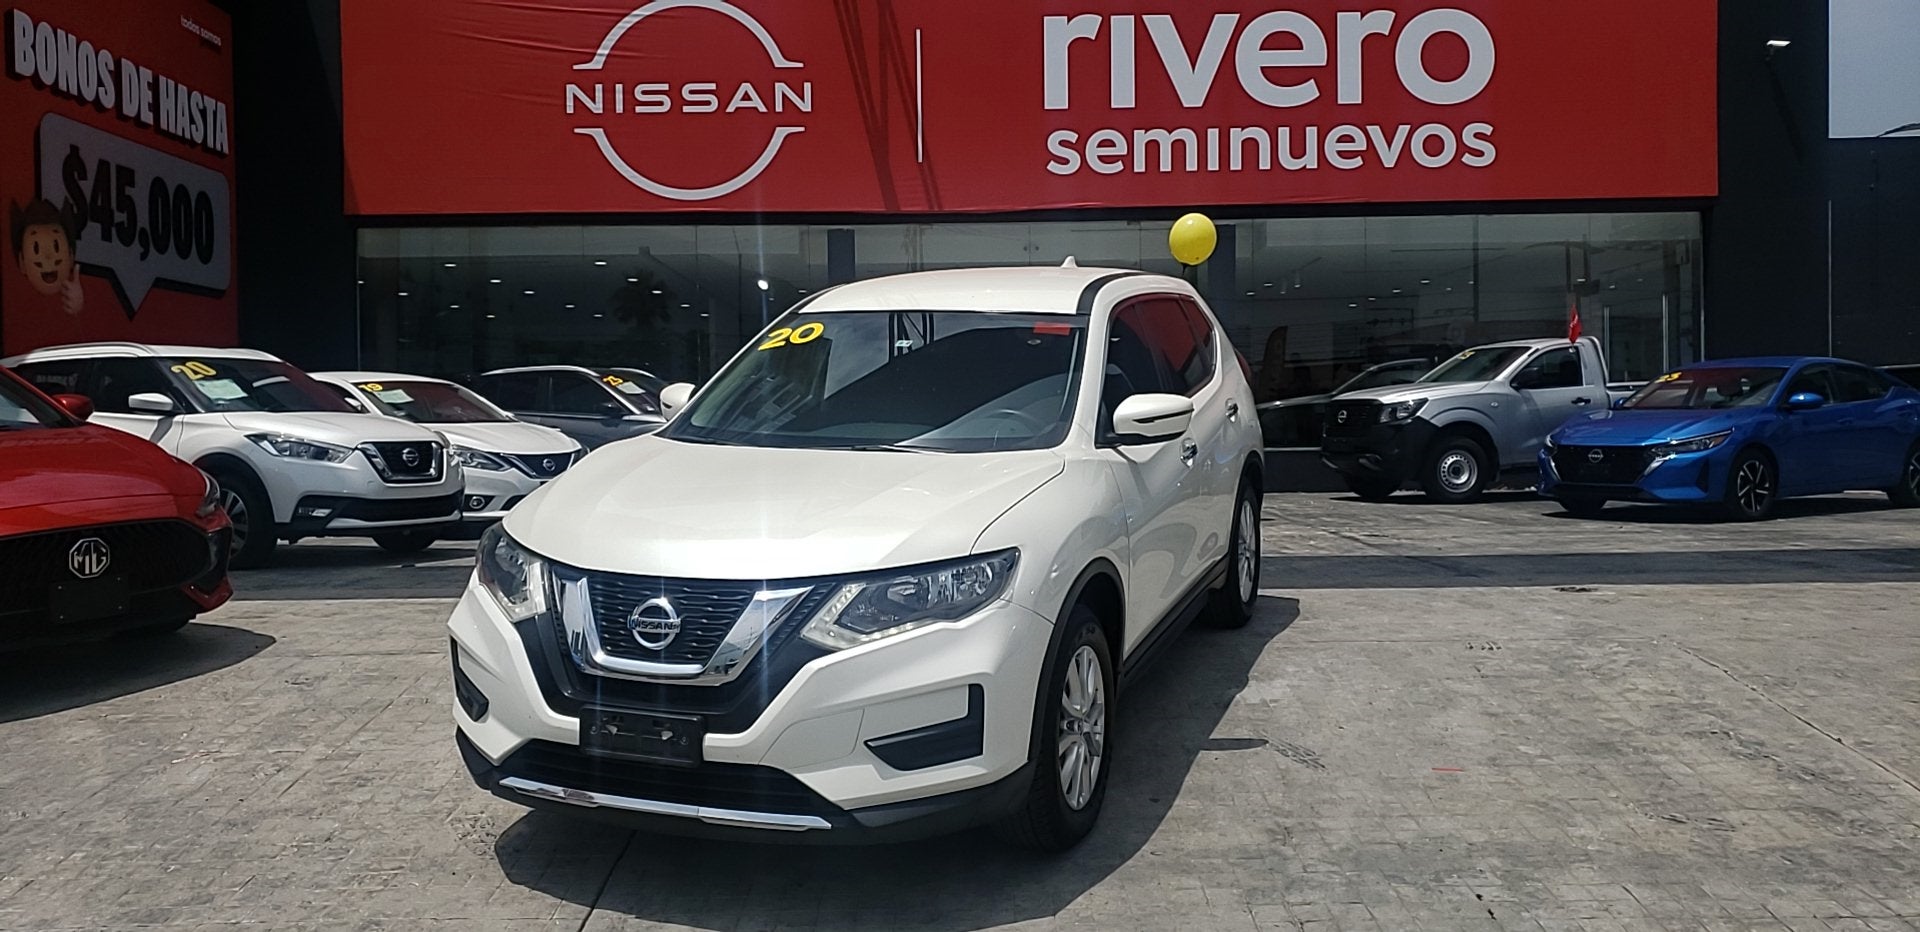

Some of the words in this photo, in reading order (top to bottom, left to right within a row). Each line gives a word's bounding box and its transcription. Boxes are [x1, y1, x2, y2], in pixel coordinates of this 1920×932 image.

[1044, 9, 1495, 110] rivero
[13, 9, 116, 110] BONOS
[121, 58, 154, 125] DE
[160, 75, 229, 154] HASTA
[566, 82, 812, 115] NISSAN
[1047, 123, 1496, 175] seminuevos
[62, 145, 215, 265] $45,000
[757, 322, 825, 351] 20
[171, 361, 217, 381] 20
[358, 383, 383, 393] 19
[74, 542, 107, 574] MG
[630, 619, 676, 631] NISSAN
